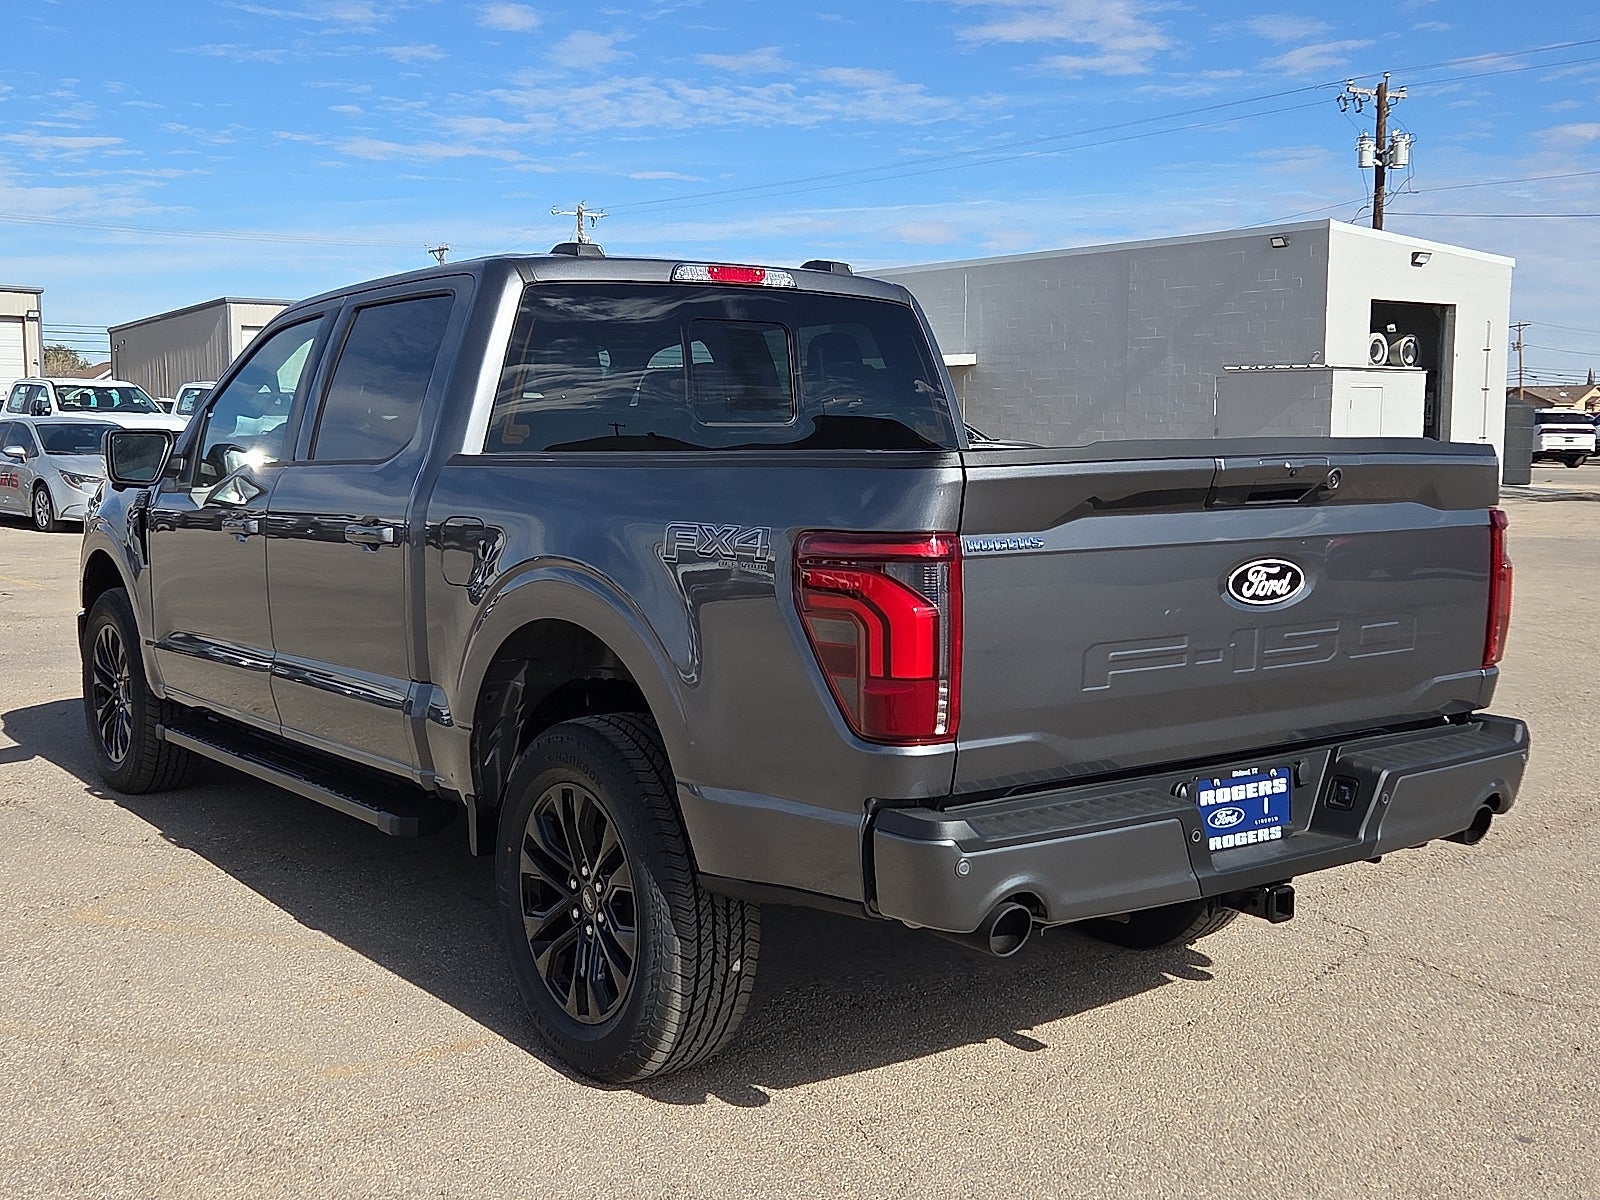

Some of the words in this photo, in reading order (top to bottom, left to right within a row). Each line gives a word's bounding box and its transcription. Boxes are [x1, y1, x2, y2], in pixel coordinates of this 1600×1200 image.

[662, 521, 771, 562] FX4
[1241, 565, 1293, 598] Ford
[1081, 614, 1416, 692] F-150
[1200, 778, 1287, 807] ROGERS
[1215, 810, 1238, 825] Ford
[1209, 826, 1281, 851] ROGERS
